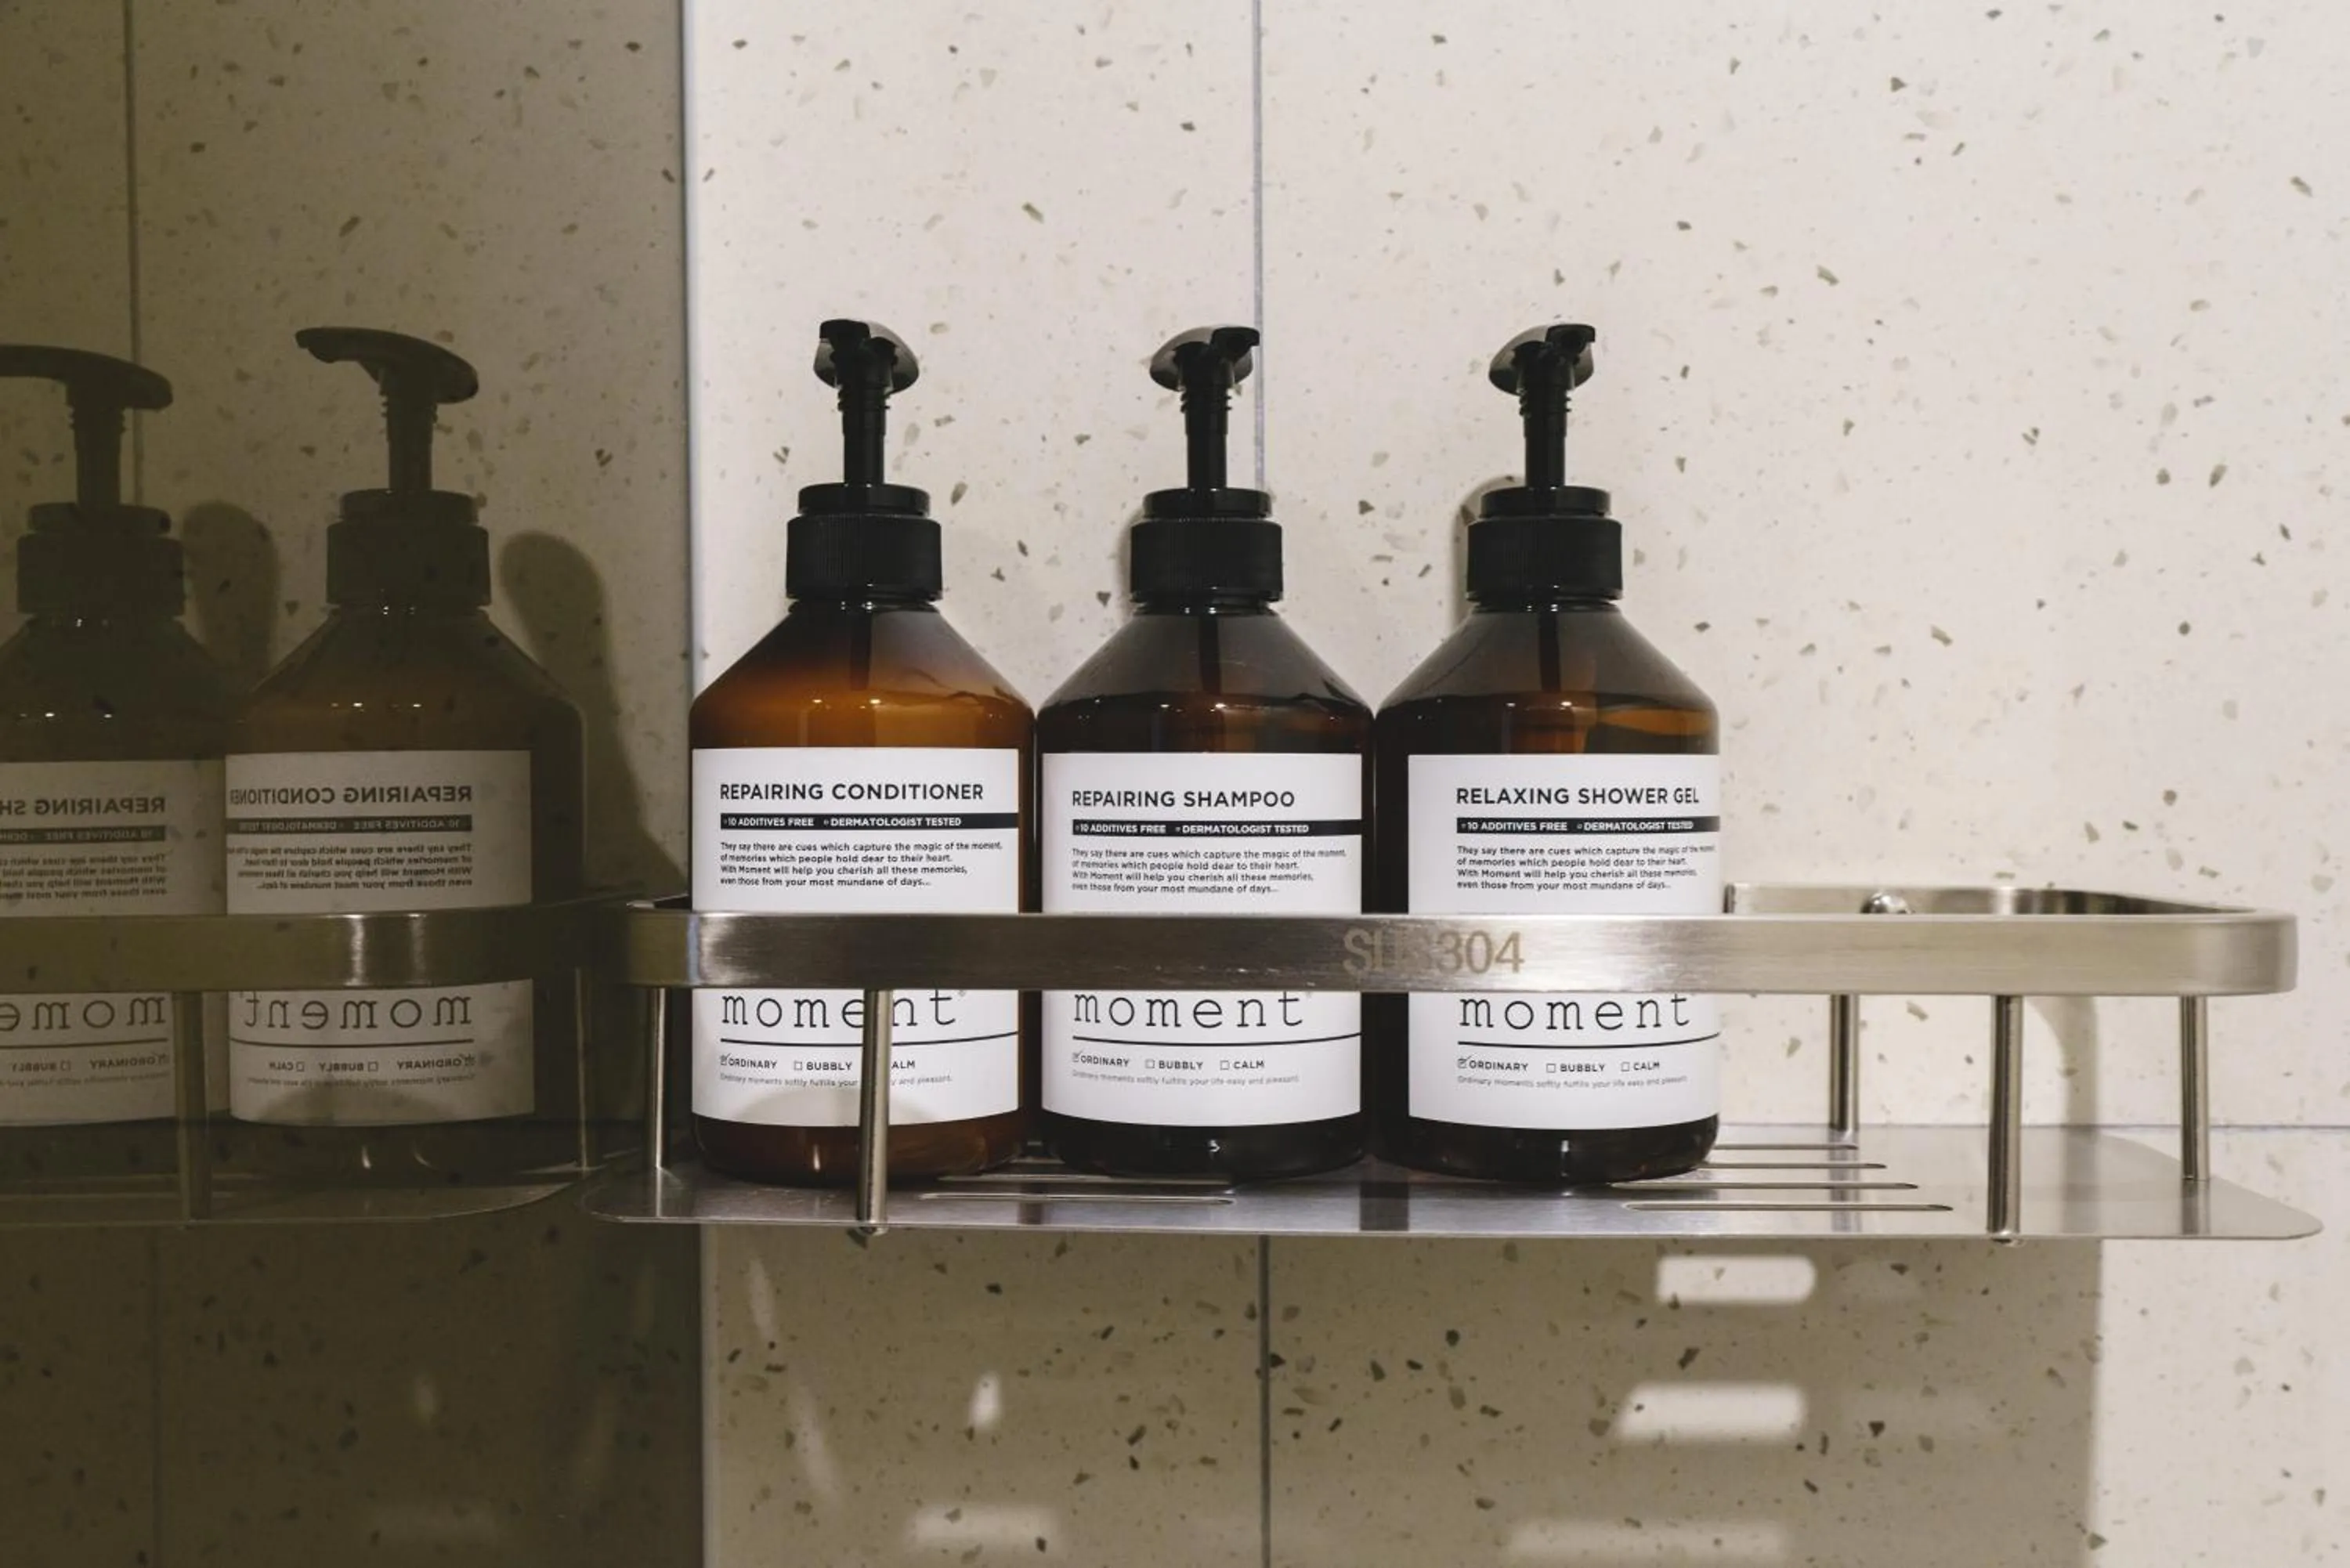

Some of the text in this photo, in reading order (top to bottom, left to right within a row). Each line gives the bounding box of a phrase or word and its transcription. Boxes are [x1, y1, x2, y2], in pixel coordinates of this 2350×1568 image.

[721, 783, 983, 800] REPAIRING CONDITIONER
[1457, 787, 1699, 804] RELAXING SHOWER GEL
[1072, 790, 1295, 807] REPAIRING SHAMPOO
[739, 818, 784, 826] ADDITIVES
[787, 818, 814, 826] FREE
[830, 817, 962, 826] DERMATOLOGIST TESTED
[1539, 822, 1567, 831] FREE
[1584, 822, 1665, 830] DERMATOLOGIST
[1090, 825, 1137, 833] ADDITIVES
[1140, 825, 1166, 834] FREE
[1182, 825, 1309, 834] DERMATOLOGIST TESTED
[821, 842, 850, 851] which
[853, 844, 891, 852] capture
[913, 842, 942, 852] magic
[1457, 845, 1478, 855] They
[1574, 846, 1603, 855] which
[799, 854, 832, 863] people
[901, 854, 924, 862] their
[1105, 849, 1127, 858] there
[1172, 850, 1201, 858] which
[1203, 851, 1242, 859] capture
[1244, 850, 1260, 858] the
[1262, 850, 1289, 859] magic
[1292, 849, 1301, 858] of
[1121, 861, 1148, 869] which
[1149, 862, 1184, 871] people
[1187, 862, 1209, 870] hold
[1212, 862, 1234, 870] dear
[1249, 862, 1271, 870] their
[1457, 858, 1467, 866] of
[1519, 858, 1549, 866] which
[1551, 859, 1586, 868] people
[773, 865, 789, 874] will
[792, 865, 813, 876] help
[815, 867, 834, 876] you
[837, 865, 873, 874] cherish
[877, 865, 888, 874] all
[891, 865, 918, 874] these
[1457, 869, 1479, 877] With
[1481, 869, 1520, 878] Moment
[1544, 869, 1567, 880] help
[1590, 869, 1625, 878] cherish
[1627, 869, 1638, 878] all
[762, 877, 783, 886] from
[786, 879, 806, 887] your
[1090, 872, 1123, 880] Moment
[1126, 873, 1141, 881] will
[1143, 873, 1165, 883] help
[1167, 874, 1185, 883] you
[1188, 873, 1224, 882] cherish
[1227, 873, 1238, 881] all
[1241, 873, 1267, 881] these
[1113, 883, 1135, 892] from
[1188, 884, 1234, 893] mundane
[1480, 881, 1508, 890] those
[1509, 881, 1534, 890] from
[1537, 883, 1560, 891] your
[722, 989, 956, 1028] moment
[1074, 991, 1303, 1028] moment
[1459, 993, 1690, 1030] moment
[728, 1058, 916, 1071] ORDINARY BUBBLY ALM
[1080, 1055, 1265, 1070] ORDINARY BUBBLY CALM
[1469, 1060, 1660, 1072] ORDINARY BUBBLY CALM
